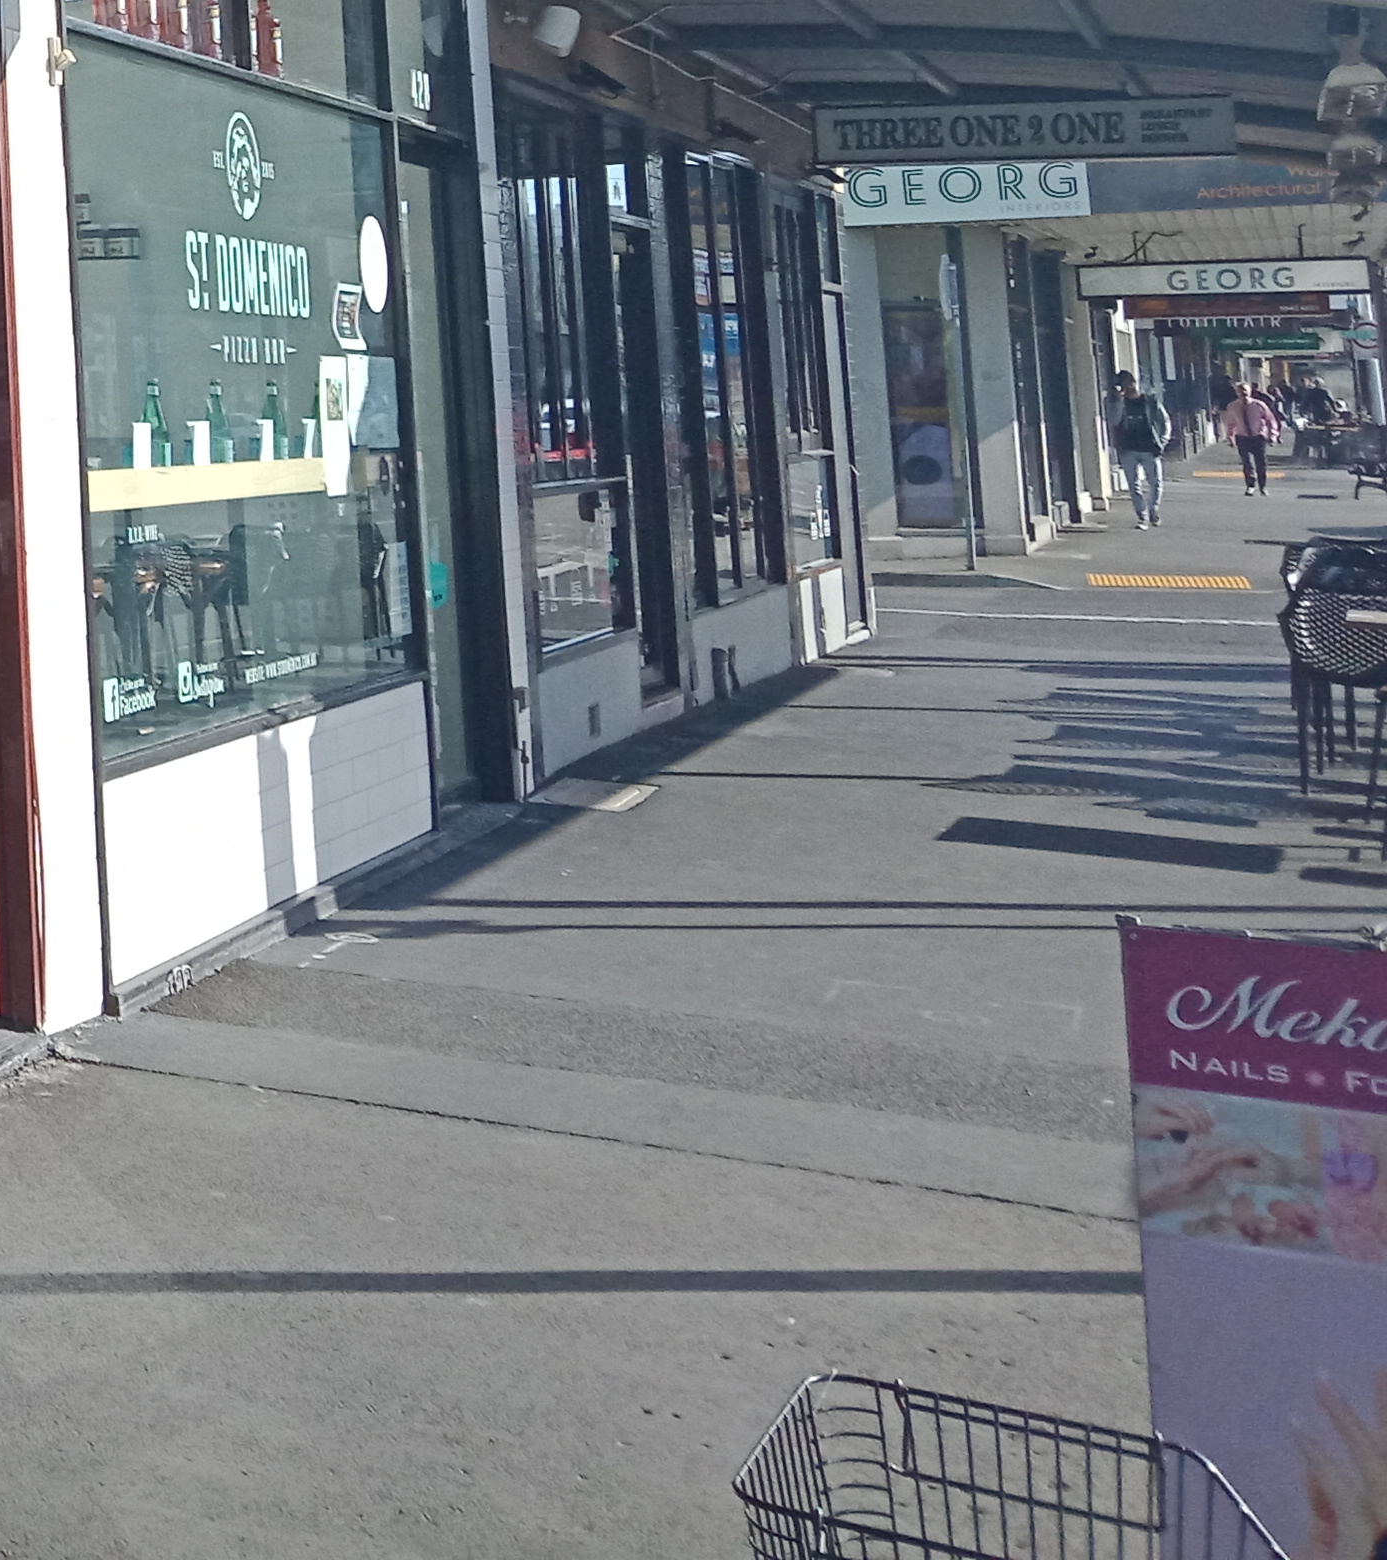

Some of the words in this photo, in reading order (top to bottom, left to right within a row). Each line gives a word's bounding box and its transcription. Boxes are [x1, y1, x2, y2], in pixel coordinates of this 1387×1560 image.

[834, 117, 944, 151] THREE
[949, 114, 1021, 148] ONE
[1050, 111, 1125, 144] ONE
[848, 161, 1078, 208] GEORG
[1197, 180, 1322, 200] Architectural
[999, 201, 1081, 214] INTERIORS
[215, 233, 311, 319] DOMENICO
[1167, 266, 1295, 291] GEORG
[119, 690, 157, 717] Facebook
